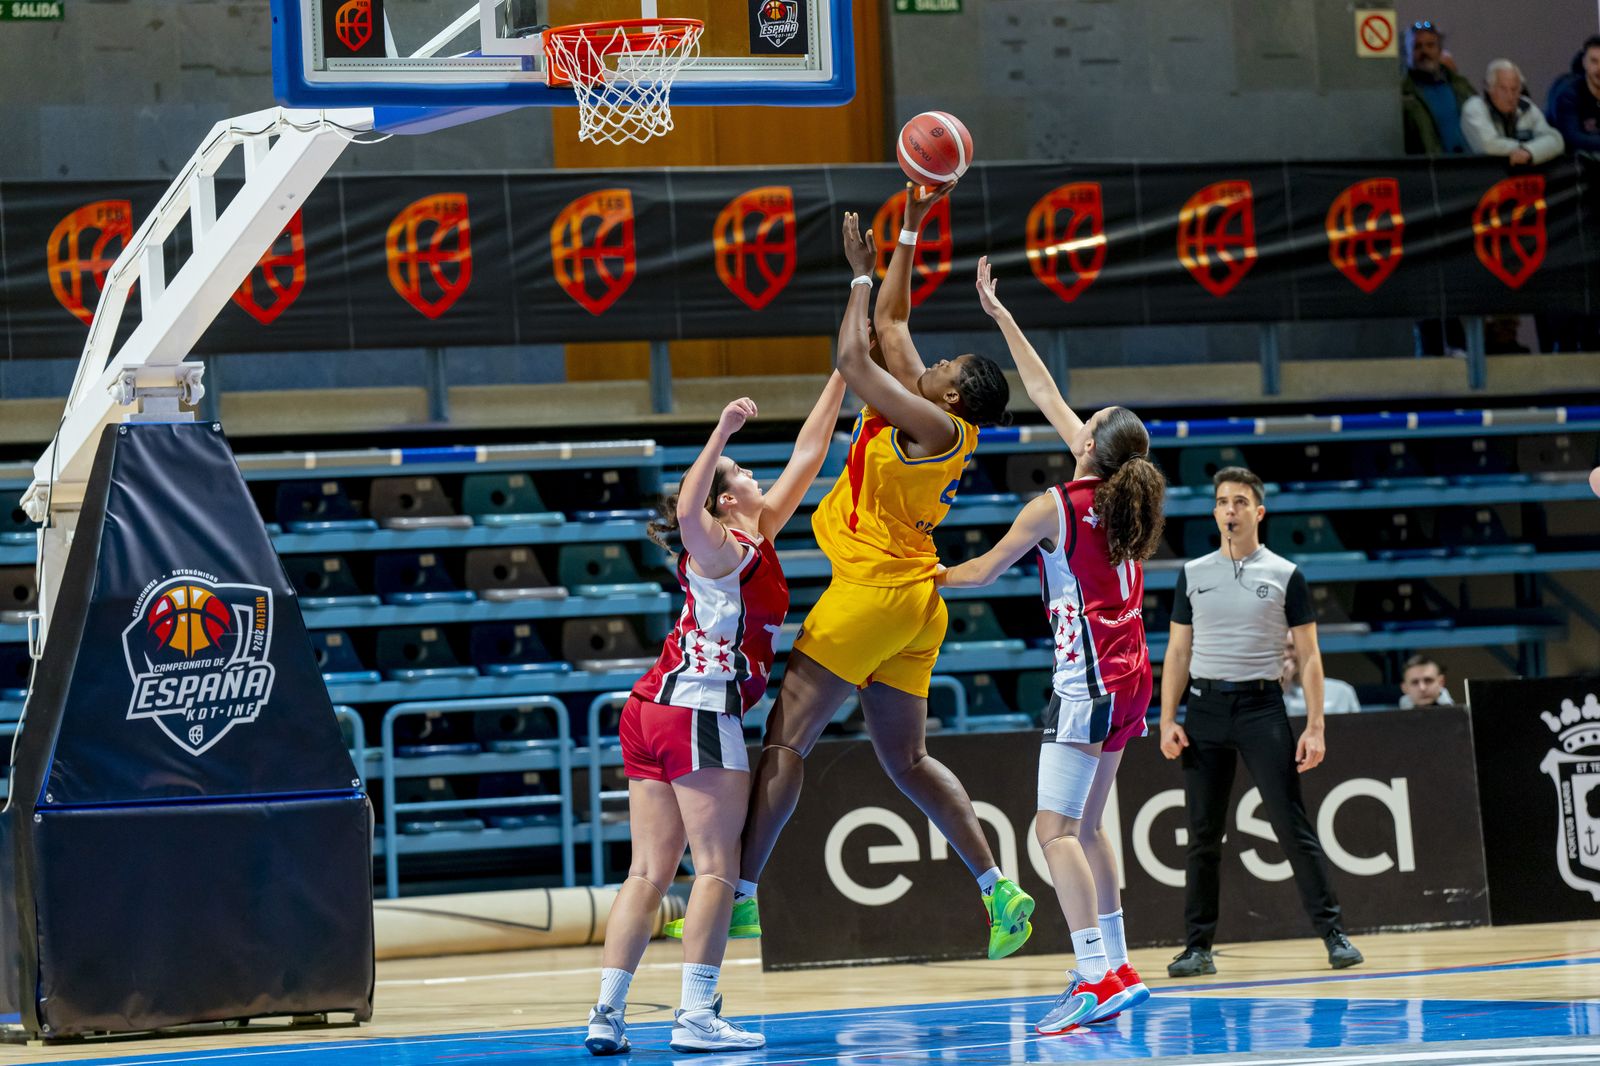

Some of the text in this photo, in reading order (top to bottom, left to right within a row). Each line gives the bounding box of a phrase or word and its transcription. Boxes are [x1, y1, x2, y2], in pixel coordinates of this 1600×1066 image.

[12, 2, 60, 18] SALIDA
[762, 23, 797, 35] ESPAÑA
[132, 579, 158, 617] SELECCIONES
[252, 597, 266, 651] HUELVA 2024
[154, 657, 225, 673] CAMPEONATO DE
[136, 665, 268, 710] ESPAÑA
